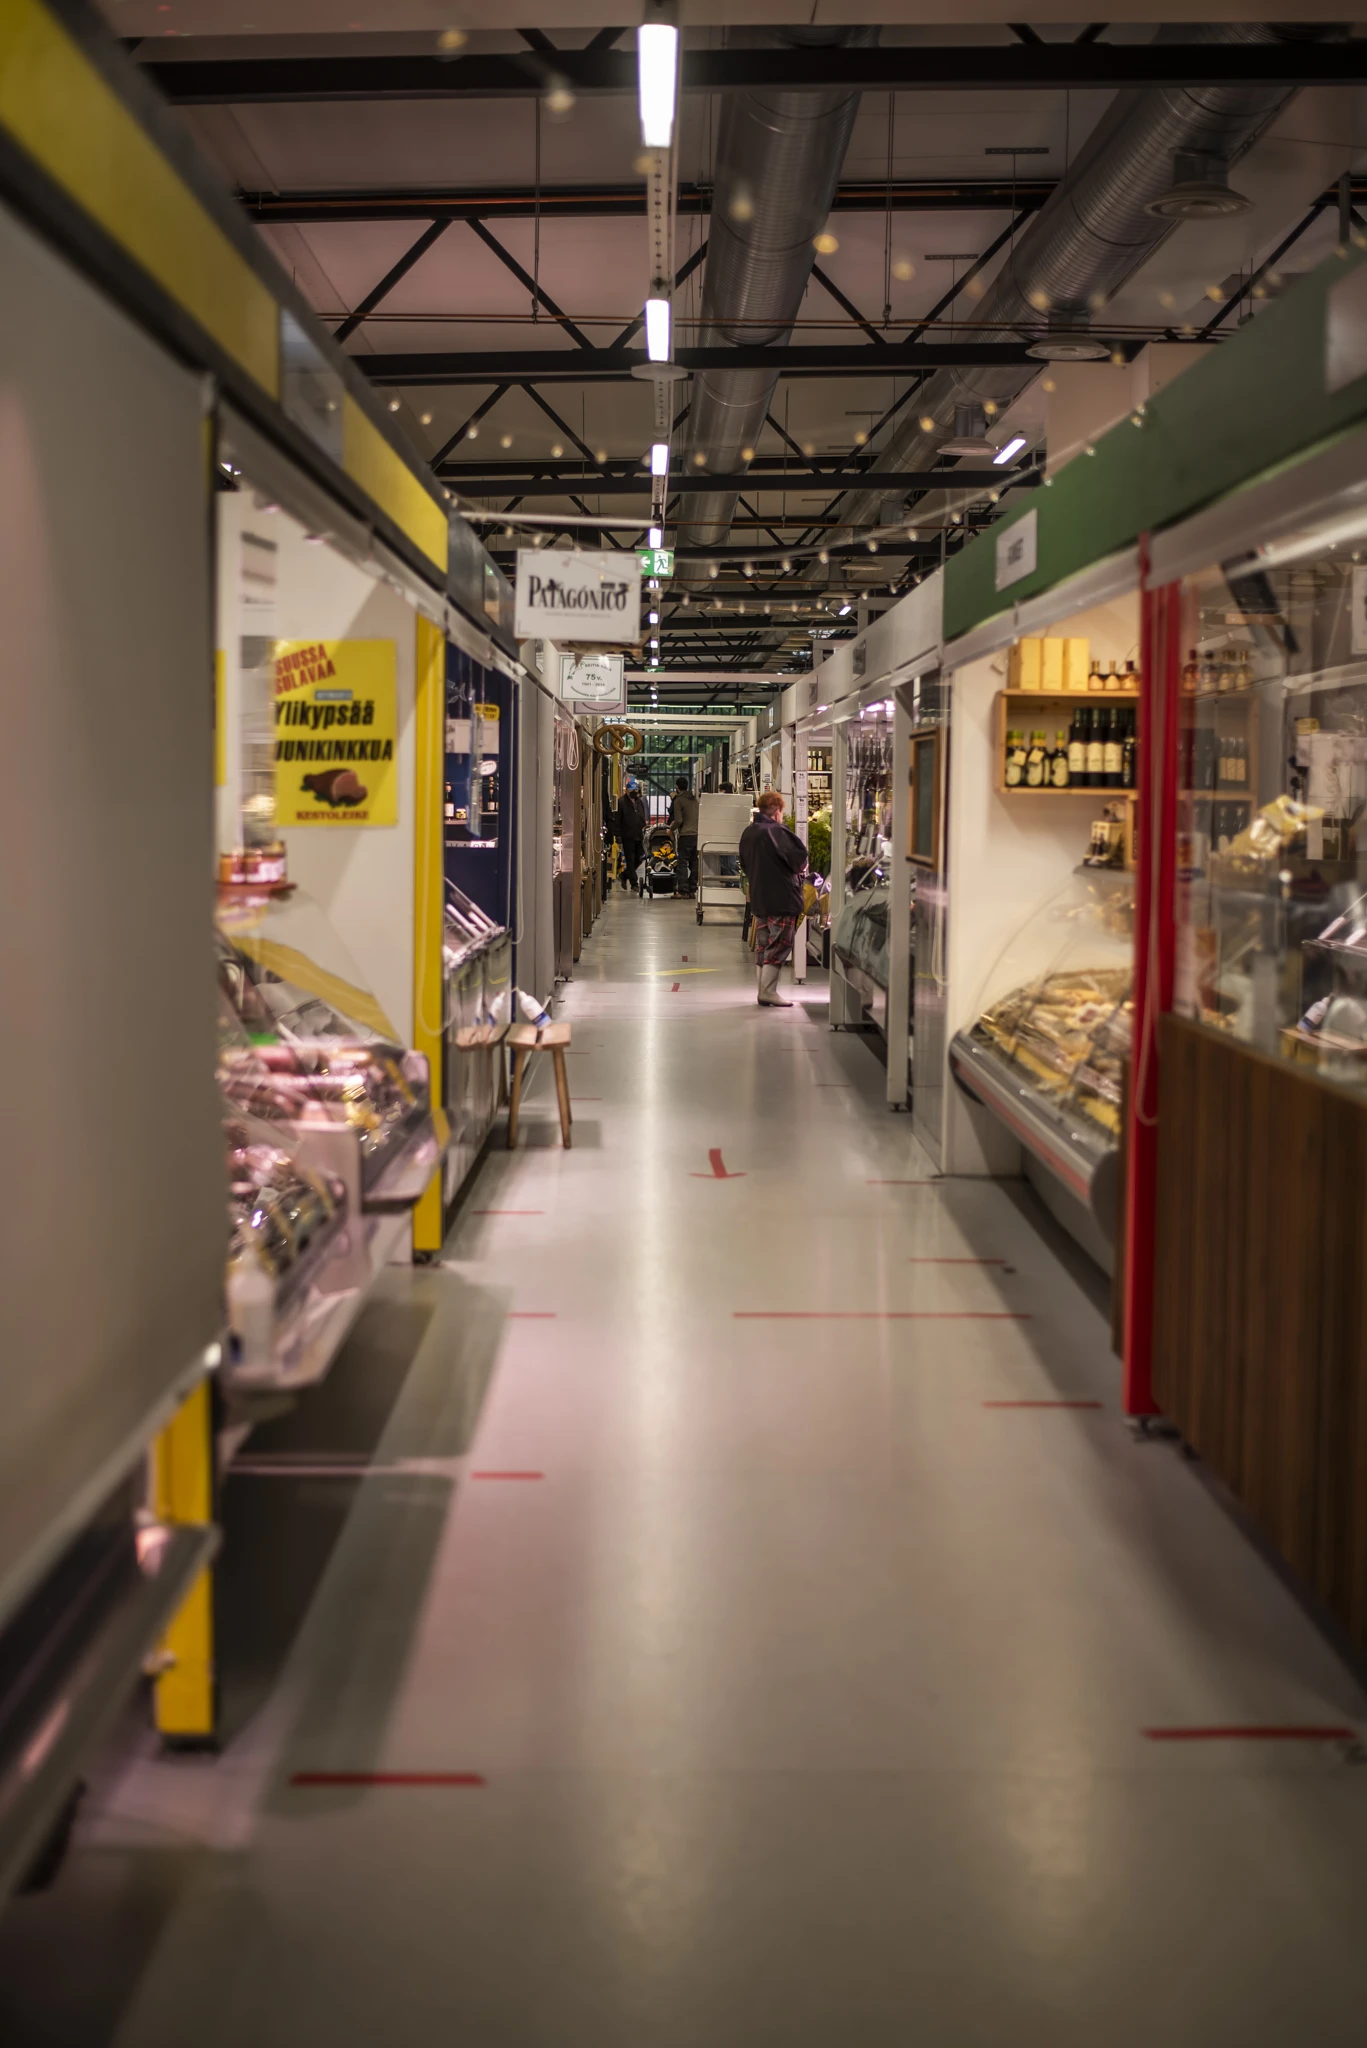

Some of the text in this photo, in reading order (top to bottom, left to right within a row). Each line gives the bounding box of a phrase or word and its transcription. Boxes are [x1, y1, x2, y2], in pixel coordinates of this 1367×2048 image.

[275, 643, 328, 676] SUUSSA
[275, 659, 336, 696] SULAVAA
[276, 700, 374, 730] Ylikypsää
